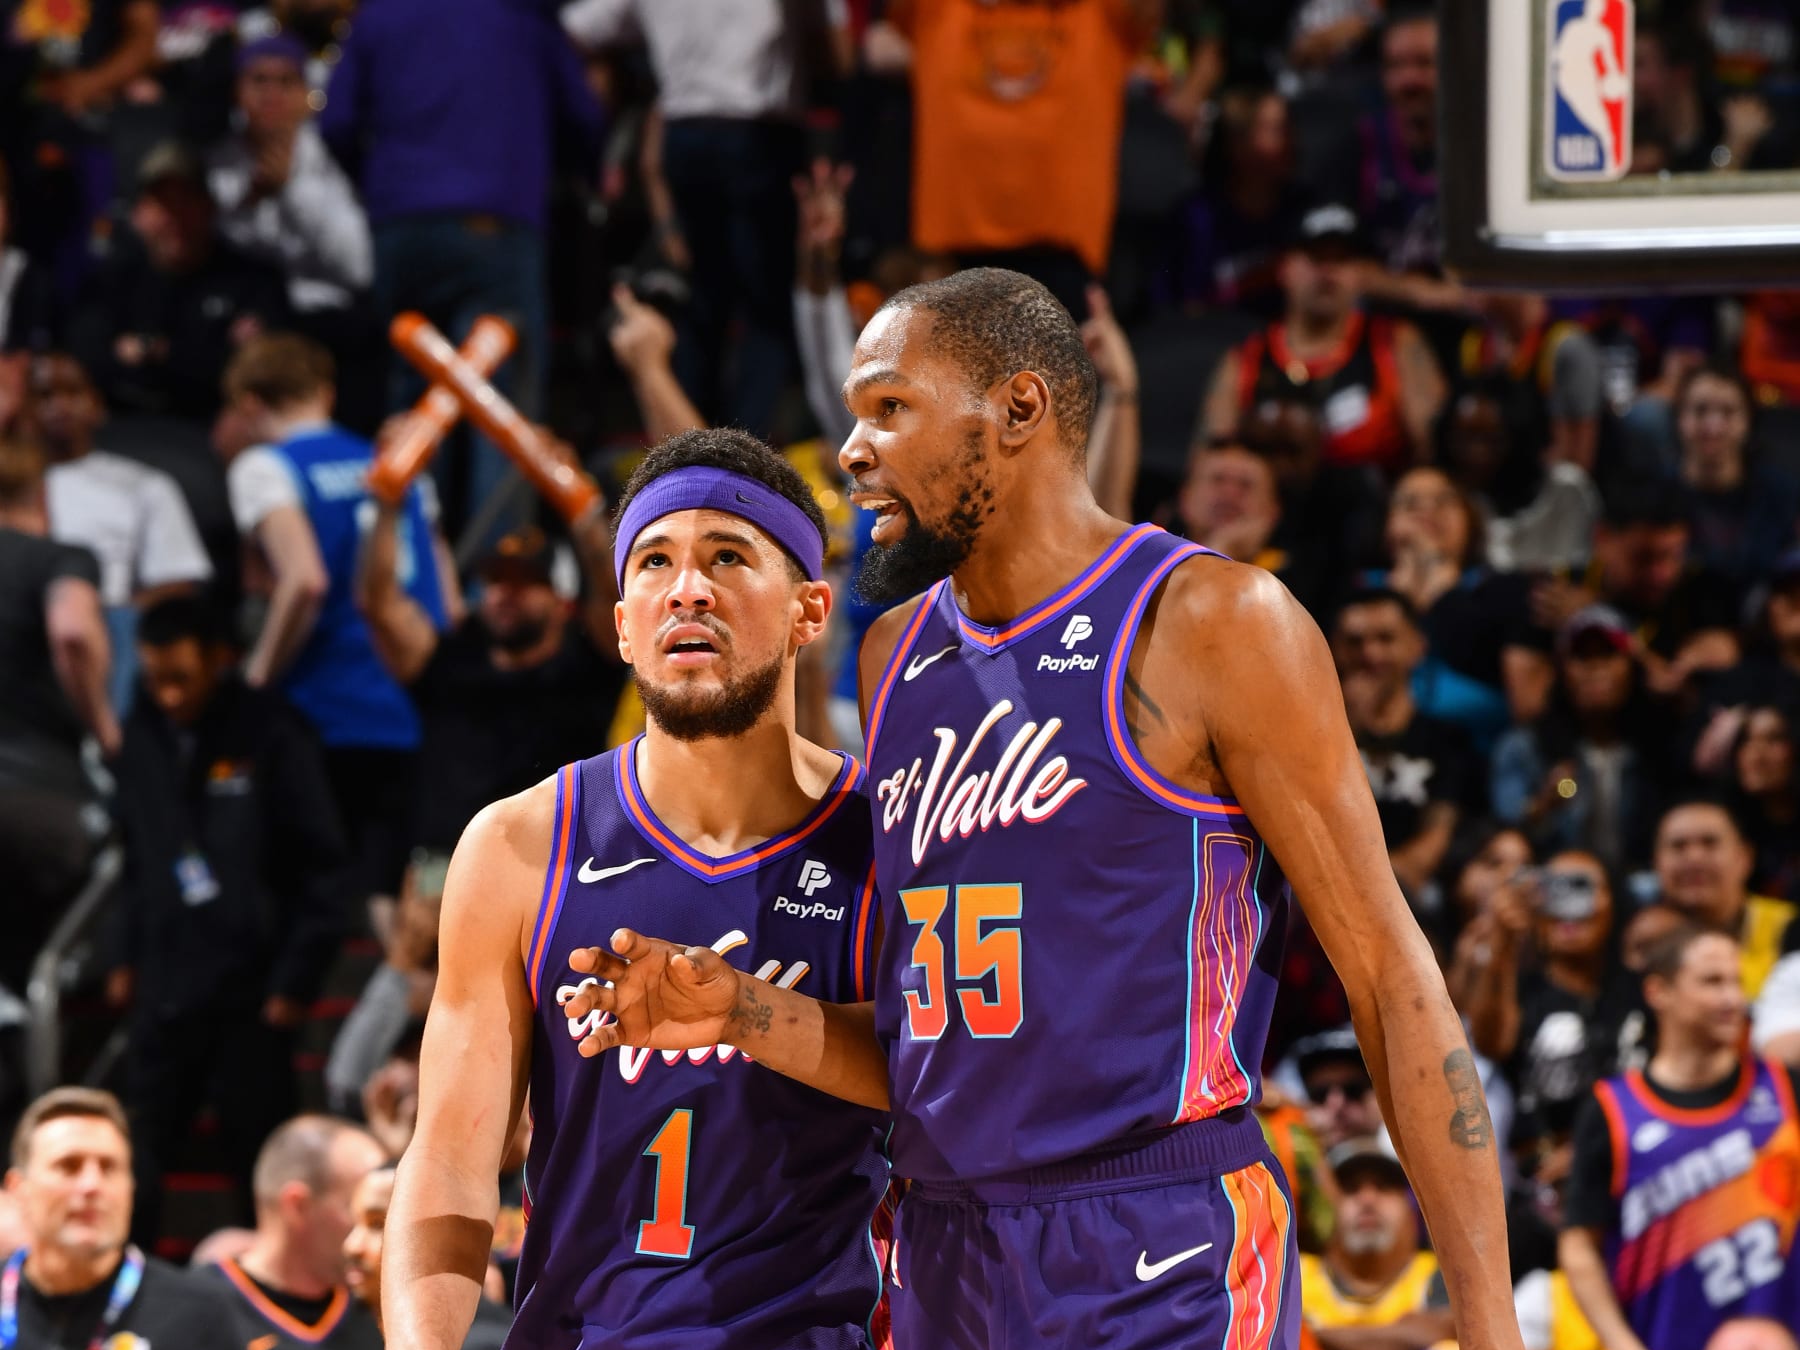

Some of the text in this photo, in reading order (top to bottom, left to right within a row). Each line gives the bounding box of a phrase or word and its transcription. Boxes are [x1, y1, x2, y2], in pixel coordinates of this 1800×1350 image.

[1558, 135, 1600, 168] NBA
[1037, 654, 1099, 673] PayPal
[912, 699, 1088, 867] Valle
[774, 896, 845, 921] PayPal
[898, 883, 1024, 1040] 35
[634, 1108, 696, 1259] 1
[1694, 1216, 1785, 1309] 22
